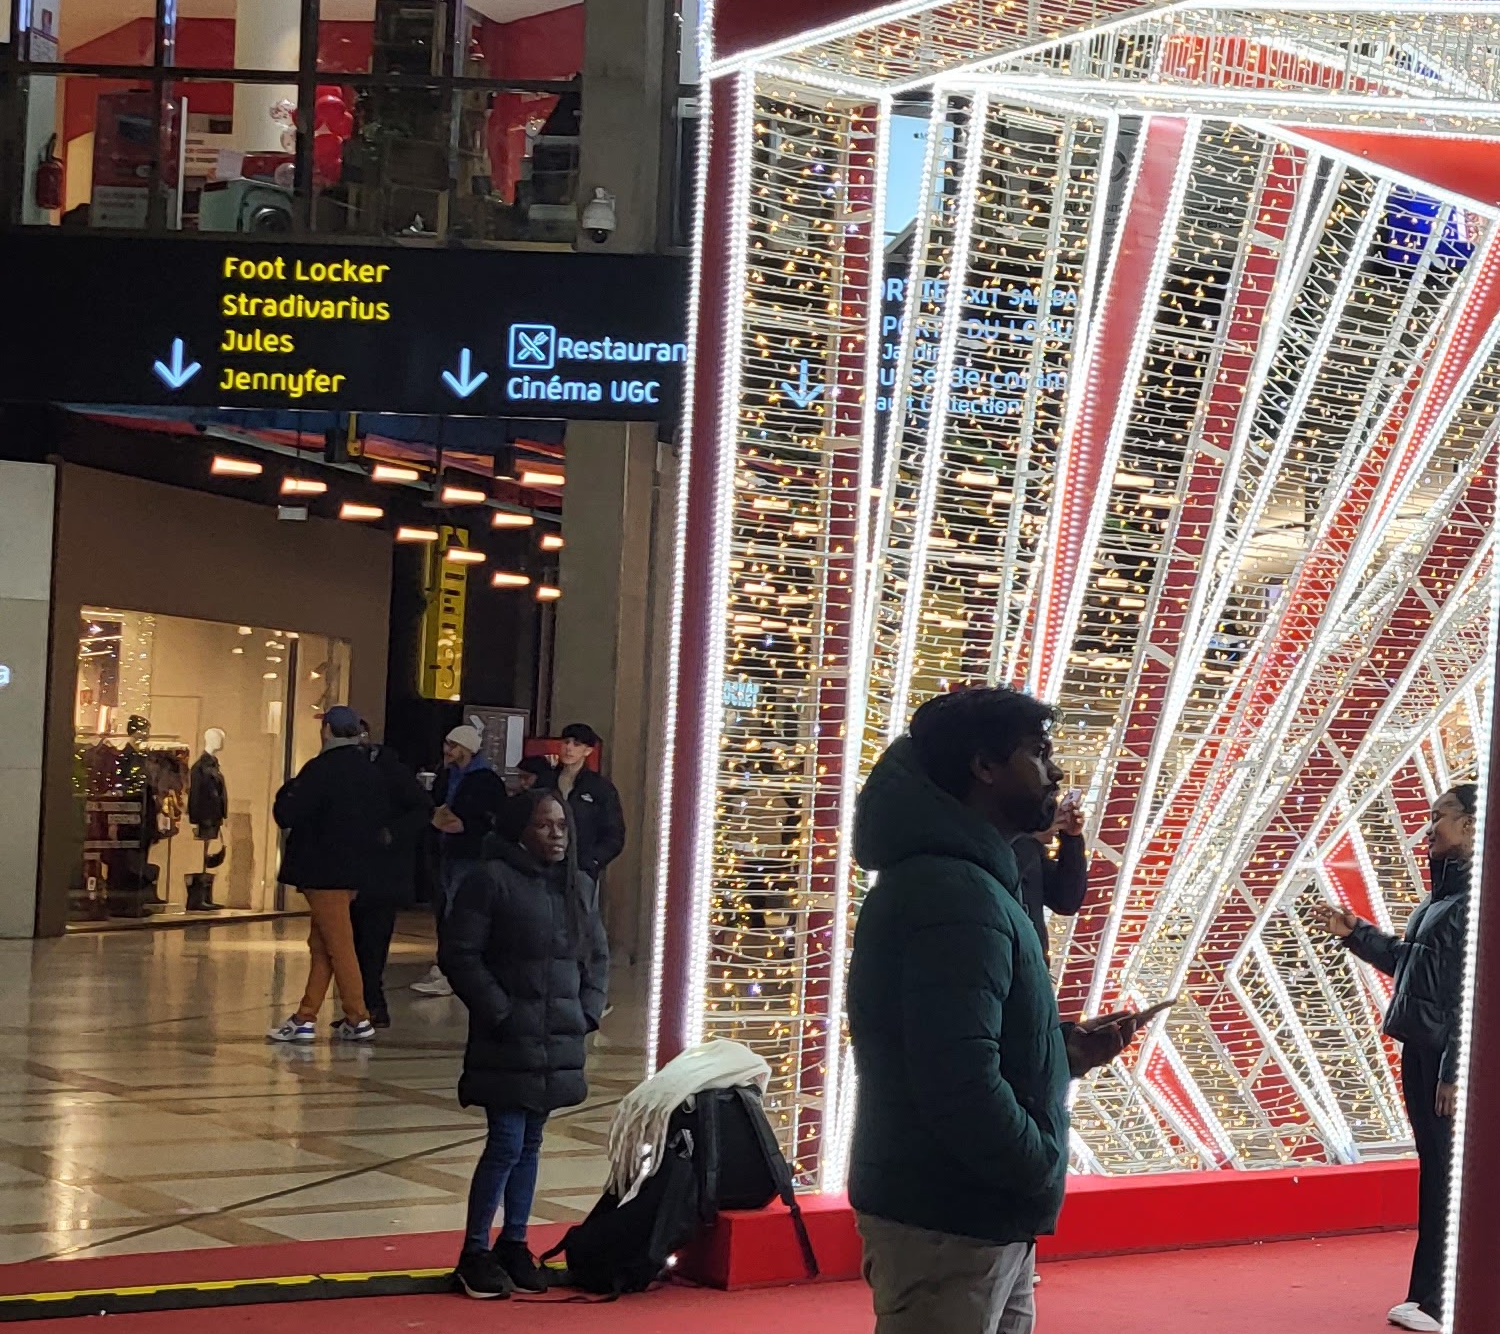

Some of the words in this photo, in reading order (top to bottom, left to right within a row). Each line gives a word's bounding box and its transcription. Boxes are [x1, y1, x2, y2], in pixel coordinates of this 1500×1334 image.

[224, 257, 286, 280] Foot
[296, 259, 390, 283] Locker
[222, 294, 391, 321] Stradivarius
[221, 329, 295, 353] Jules
[219, 369, 346, 398] Jennyfer
[507, 376, 602, 401] Cinéma
[611, 380, 660, 403] UGC
